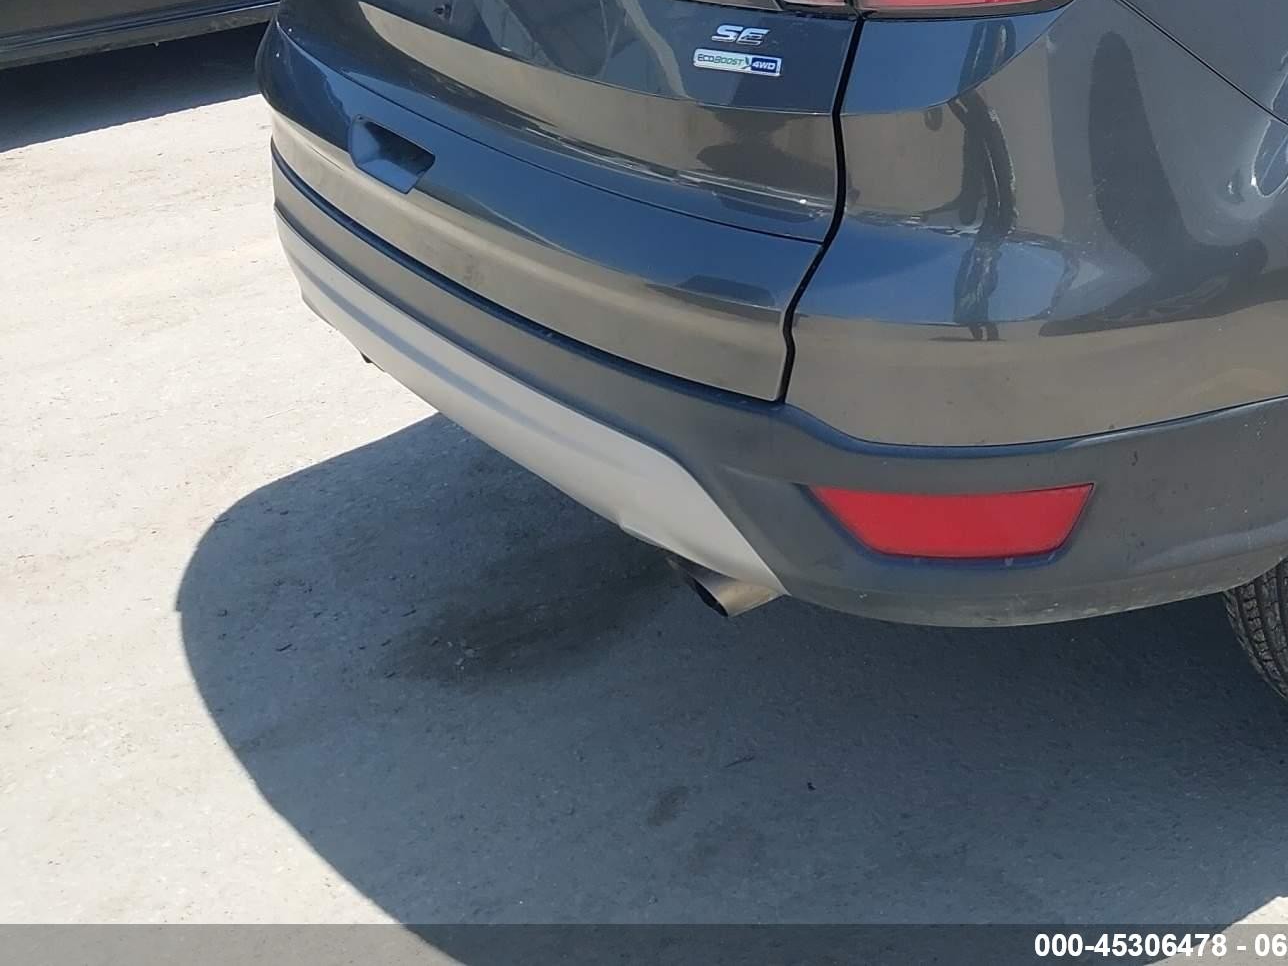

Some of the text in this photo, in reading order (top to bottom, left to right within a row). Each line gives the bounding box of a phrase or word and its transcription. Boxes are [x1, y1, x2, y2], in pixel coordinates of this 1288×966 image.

[711, 24, 770, 46] SE
[697, 53, 776, 71] ECOBOOST 4WD
